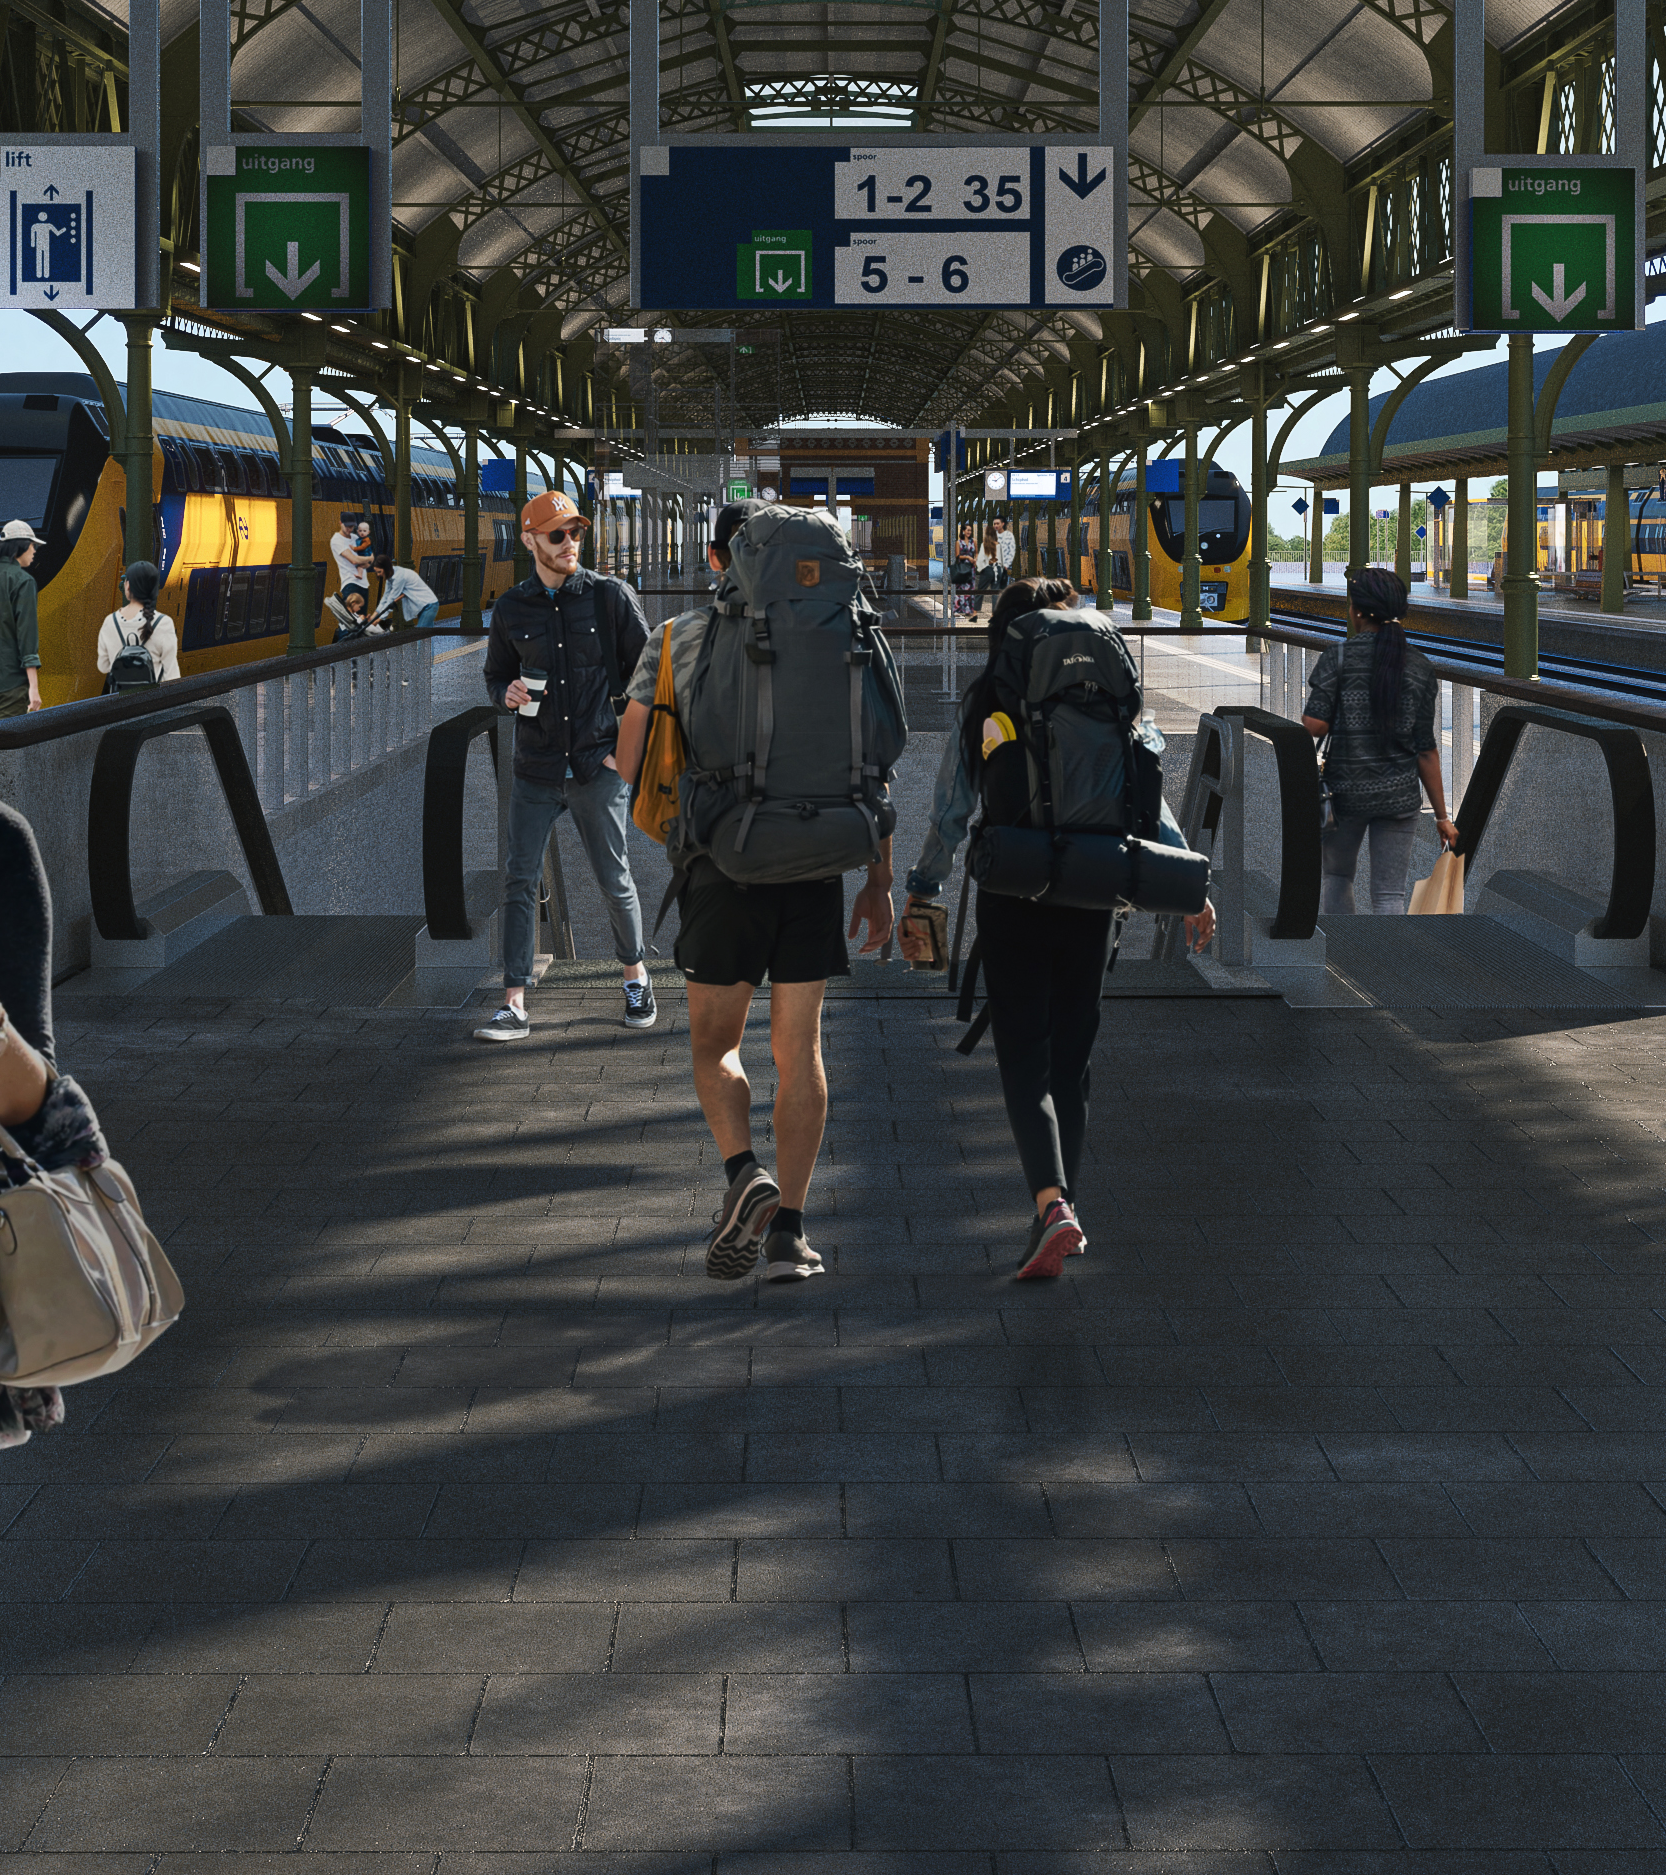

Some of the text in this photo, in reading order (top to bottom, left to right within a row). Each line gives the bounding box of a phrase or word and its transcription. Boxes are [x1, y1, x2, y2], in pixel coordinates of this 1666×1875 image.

[5, 151, 32, 167] lift
[242, 155, 315, 173] uitgang
[852, 153, 877, 161] spoor
[1508, 176, 1581, 195] uitgang
[857, 175, 1023, 213] 1-2 35
[754, 235, 787, 244] uitgang
[852, 237, 877, 246] spoor
